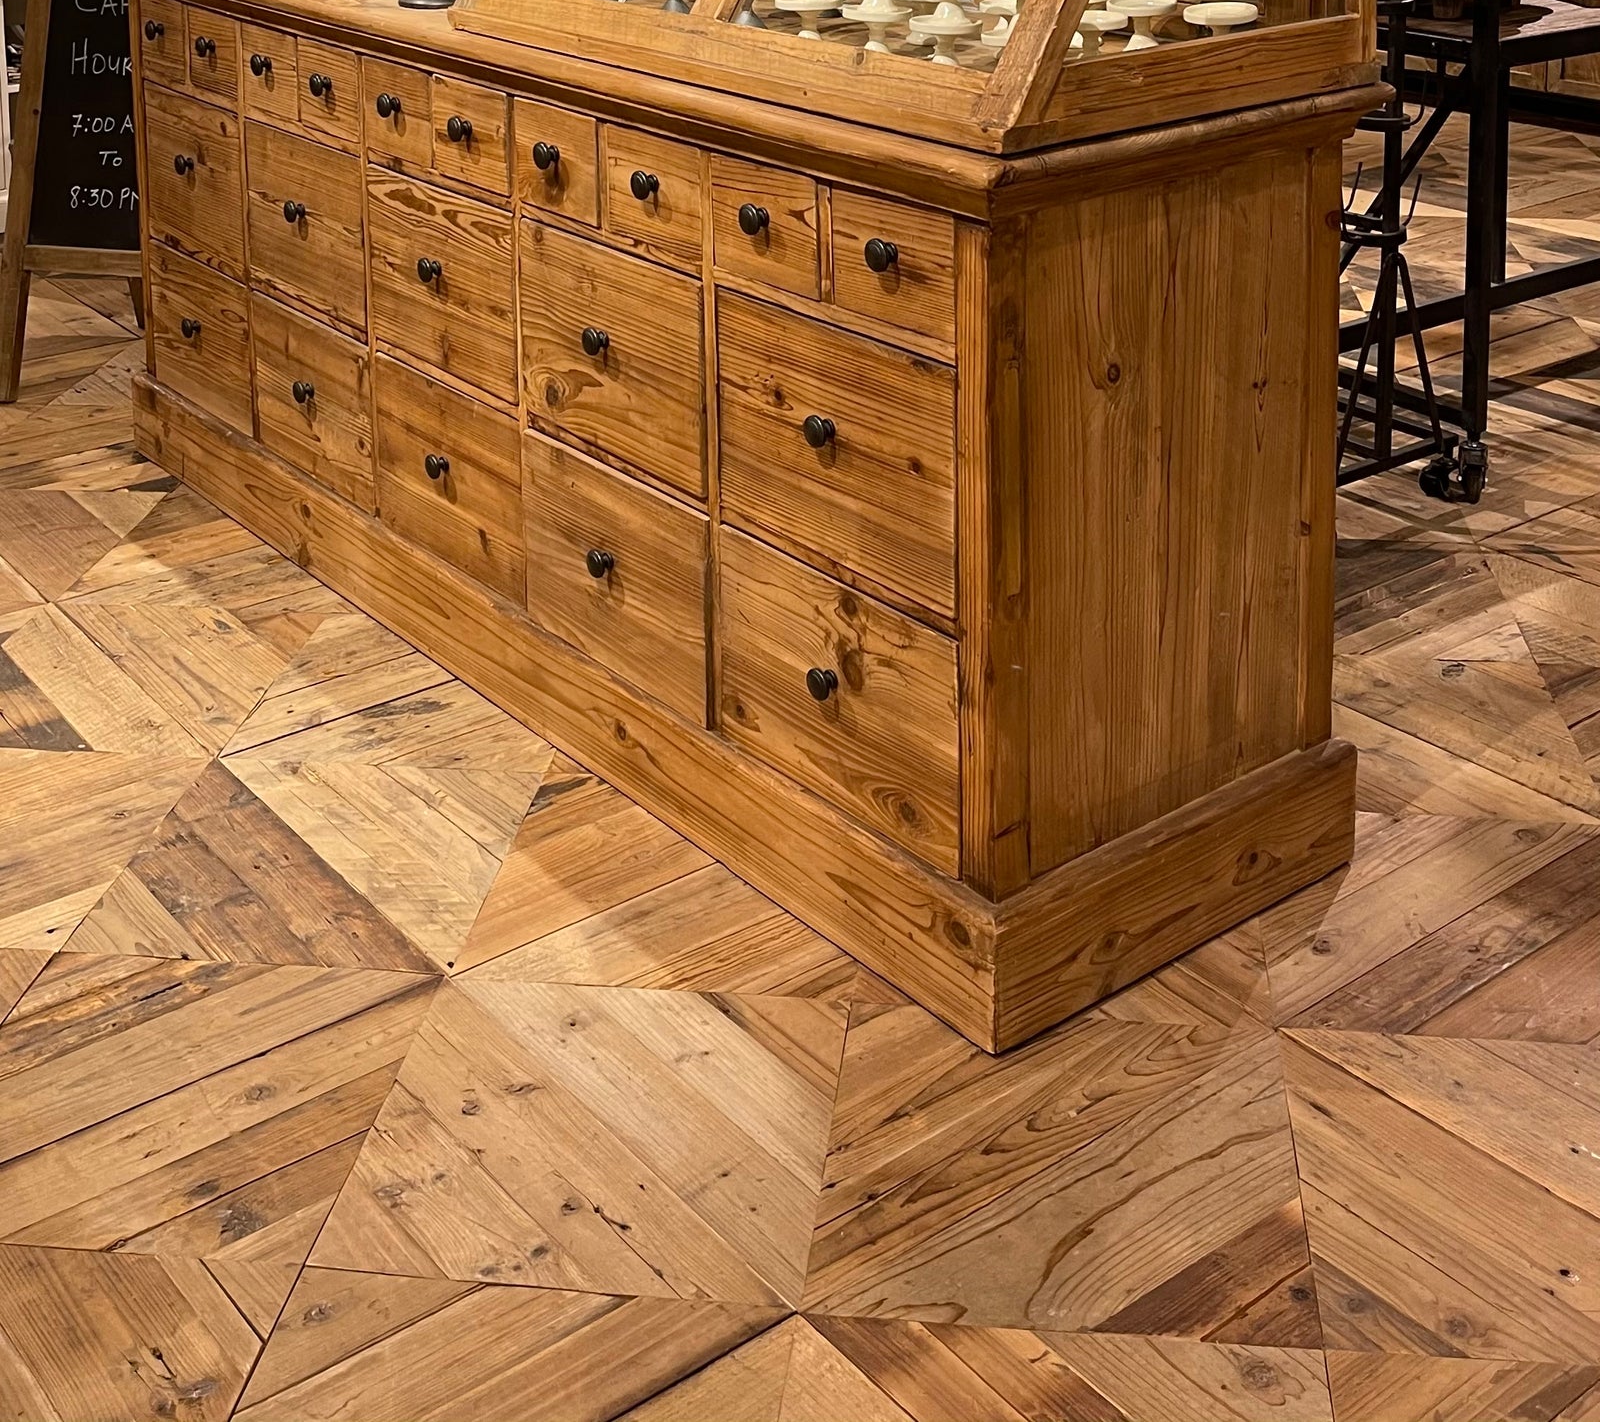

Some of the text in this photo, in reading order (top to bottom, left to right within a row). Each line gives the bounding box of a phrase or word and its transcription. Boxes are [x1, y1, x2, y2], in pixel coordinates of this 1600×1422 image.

[71, 37, 133, 76] HOUR
[72, 113, 134, 137] 7:00 A
[69, 185, 114, 210] 8:30
